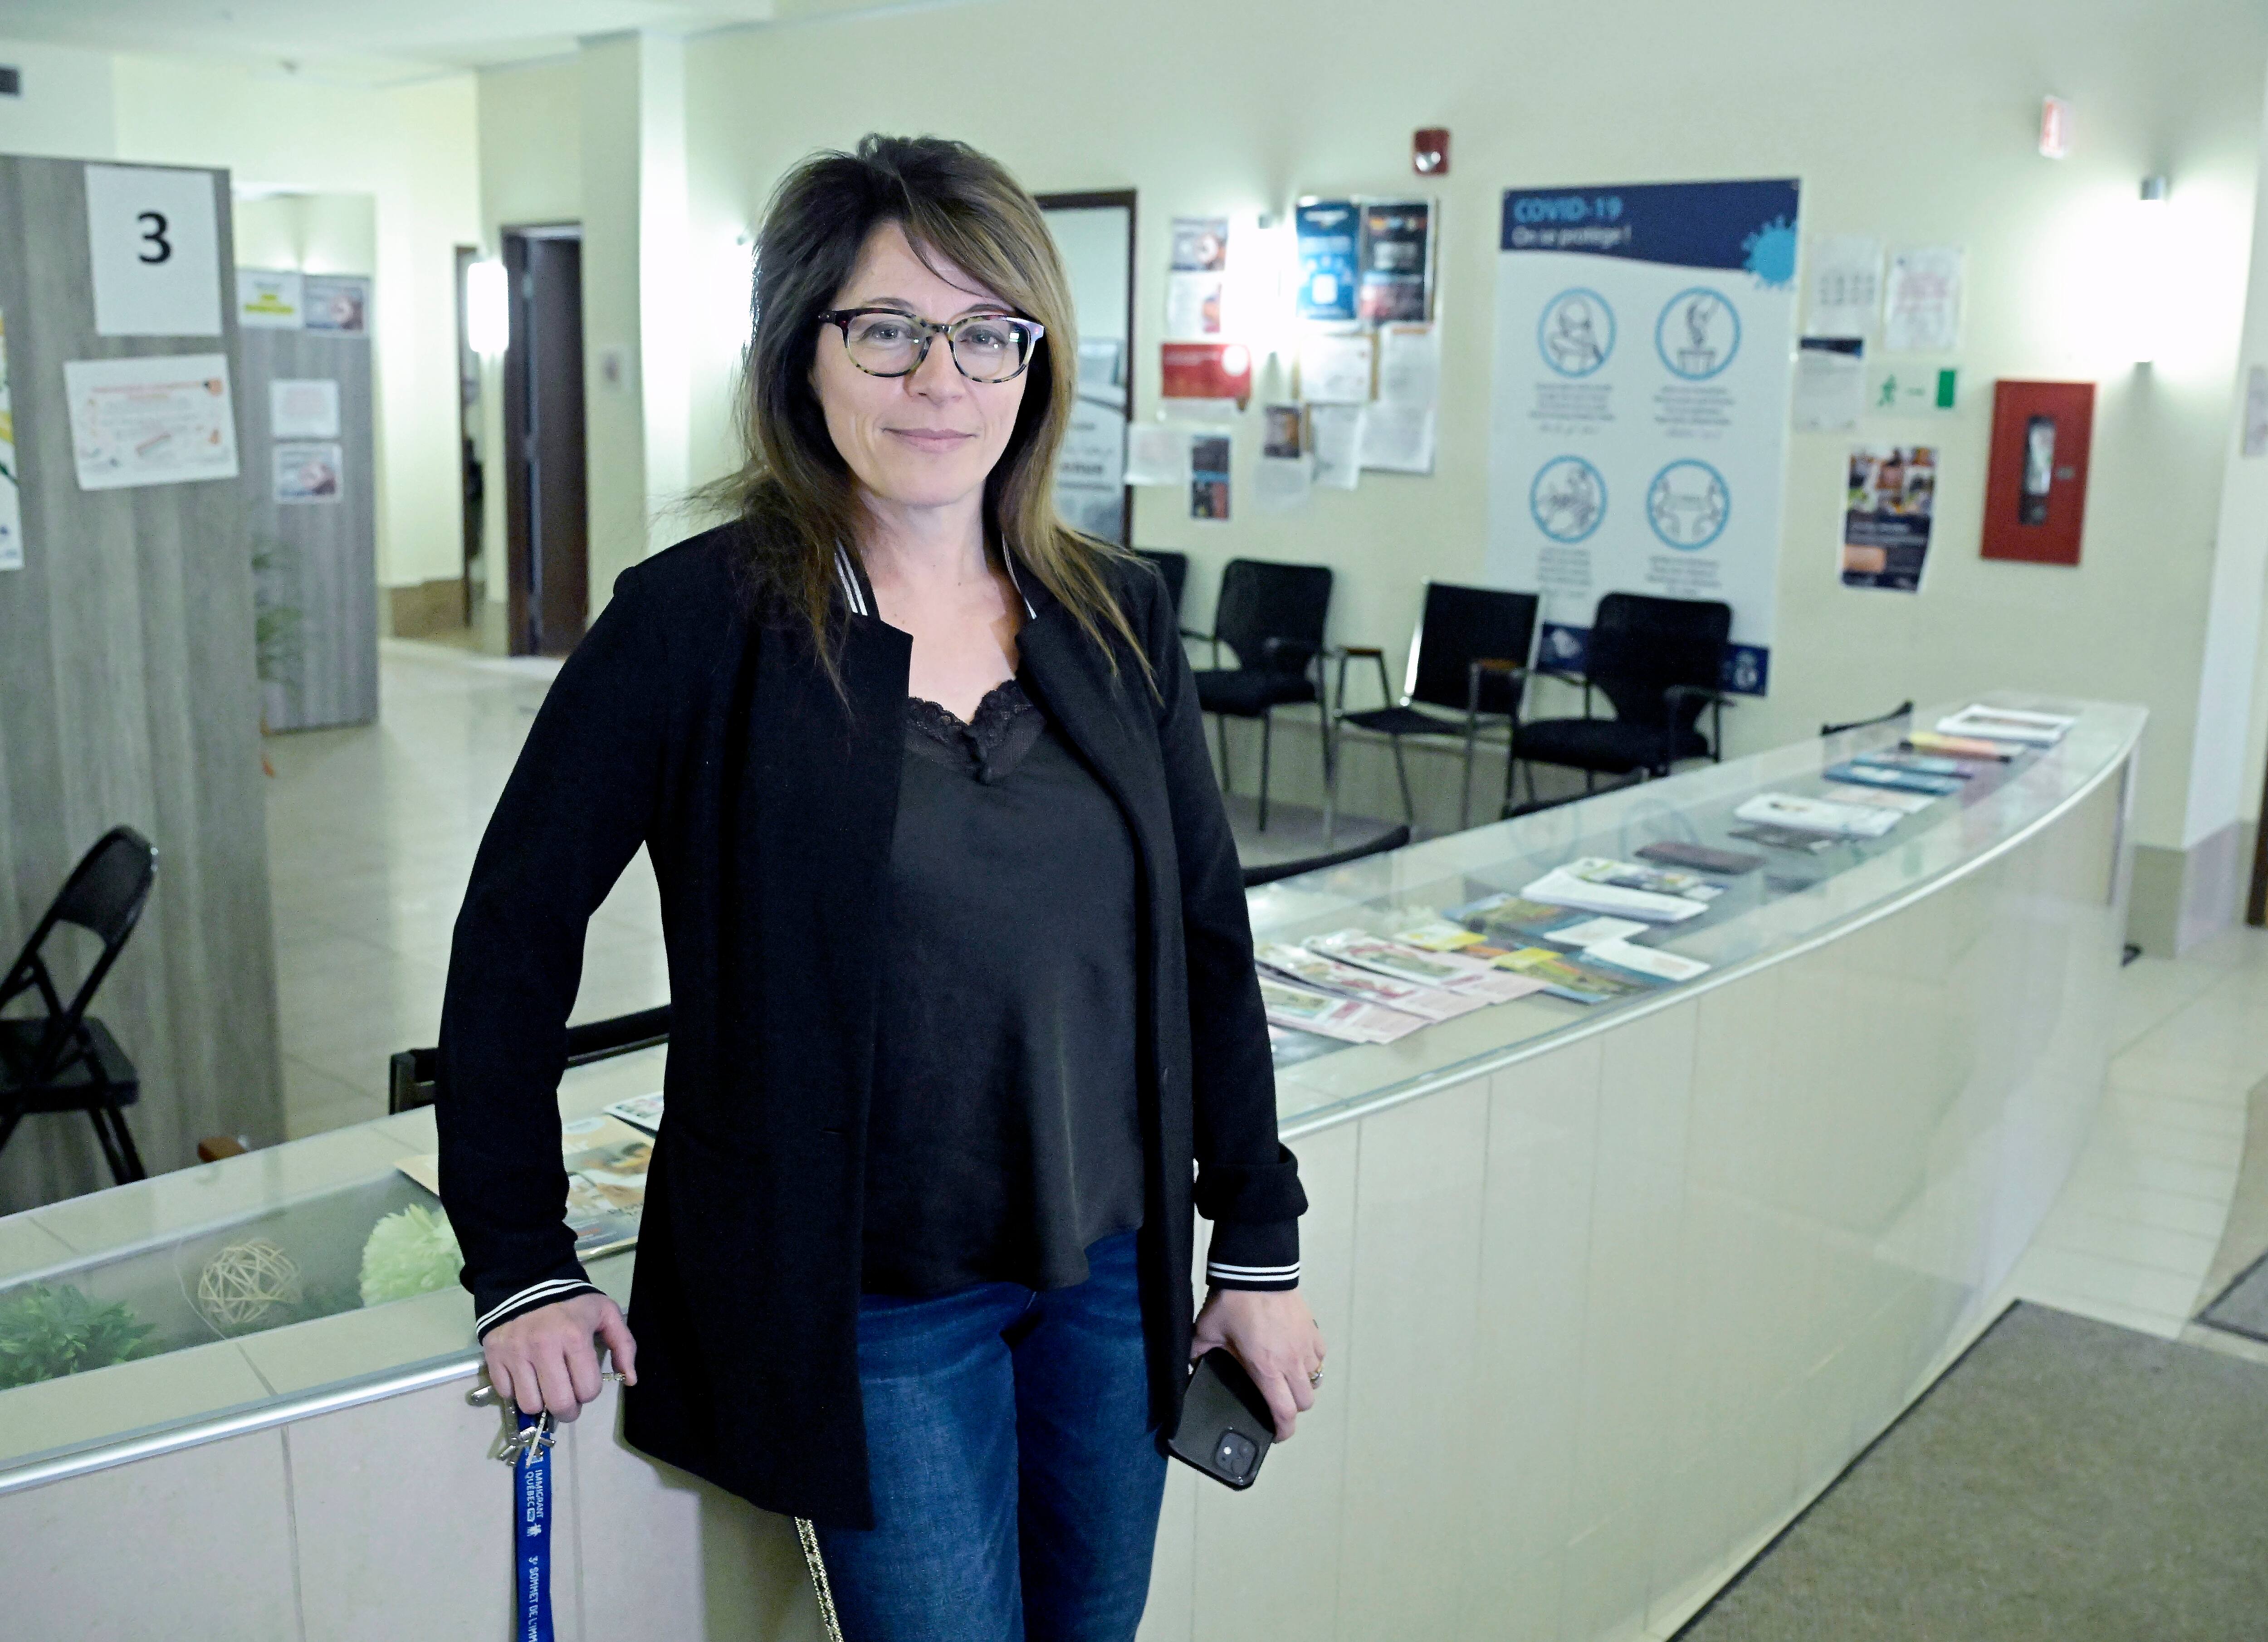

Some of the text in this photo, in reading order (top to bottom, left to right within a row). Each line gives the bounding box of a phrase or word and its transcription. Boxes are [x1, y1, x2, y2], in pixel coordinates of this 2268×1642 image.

[1514, 195, 1622, 221] COVID-19
[138, 211, 171, 264] 3
[535, 1470, 543, 1517] IMMIGRANT
[529, 1567, 539, 1603] SOMMET
[529, 1604, 538, 1618] DE
